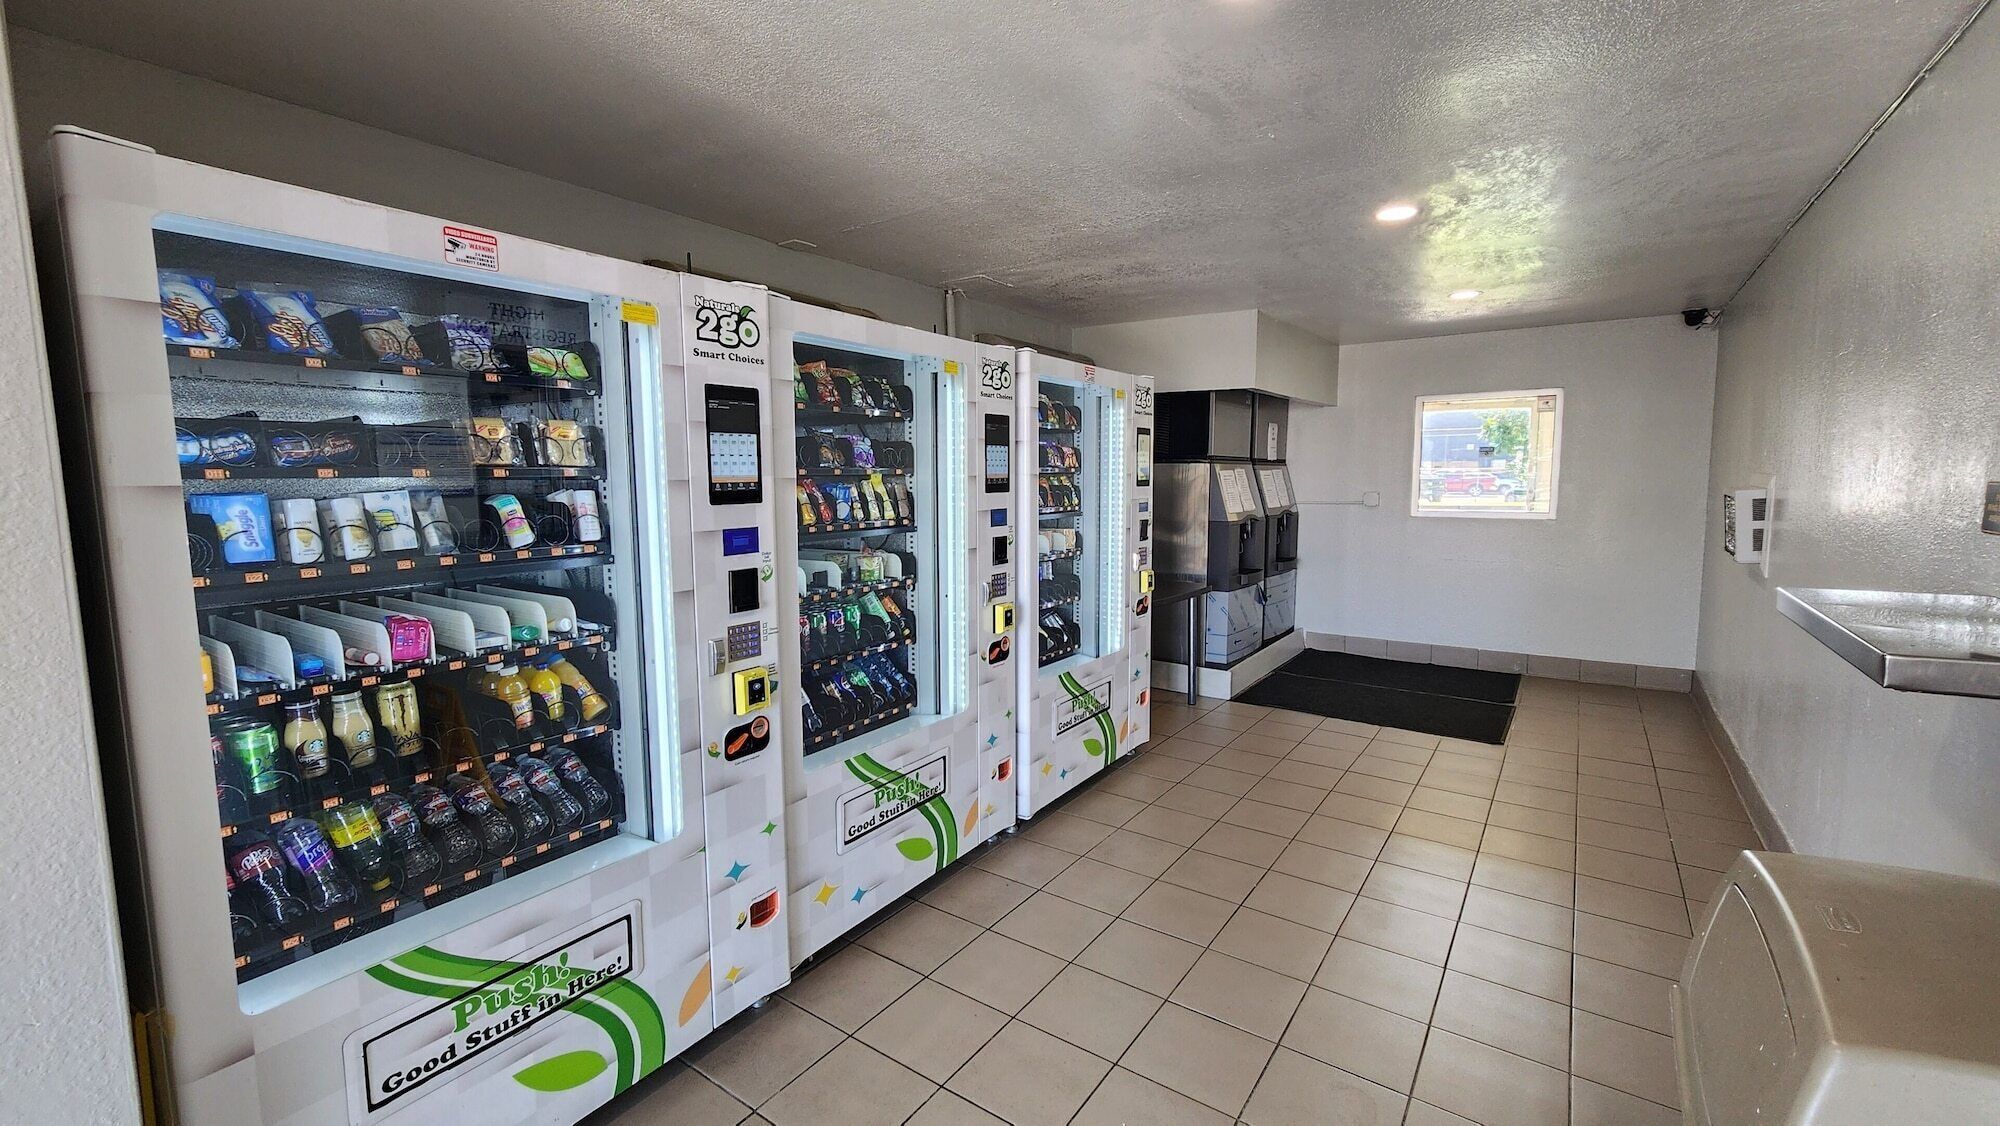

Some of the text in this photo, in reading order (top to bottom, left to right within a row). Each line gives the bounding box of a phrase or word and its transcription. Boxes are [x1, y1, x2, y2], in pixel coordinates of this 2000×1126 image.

[469, 243, 495, 253] WARNING
[694, 294, 741, 314] Naturals
[693, 348, 766, 365] Smart Choices
[980, 391, 995, 399] Smart
[234, 509, 260, 547] Snuggle
[1072, 690, 1097, 713] Push!
[1058, 717, 1073, 731] Good
[1073, 711, 1088, 723] Stuff
[873, 771, 921, 809] Push!
[848, 782, 942, 837] Good Stuff in Here!
[450, 951, 572, 1034] Push!
[381, 955, 623, 1094] Good Stuff in Here!
